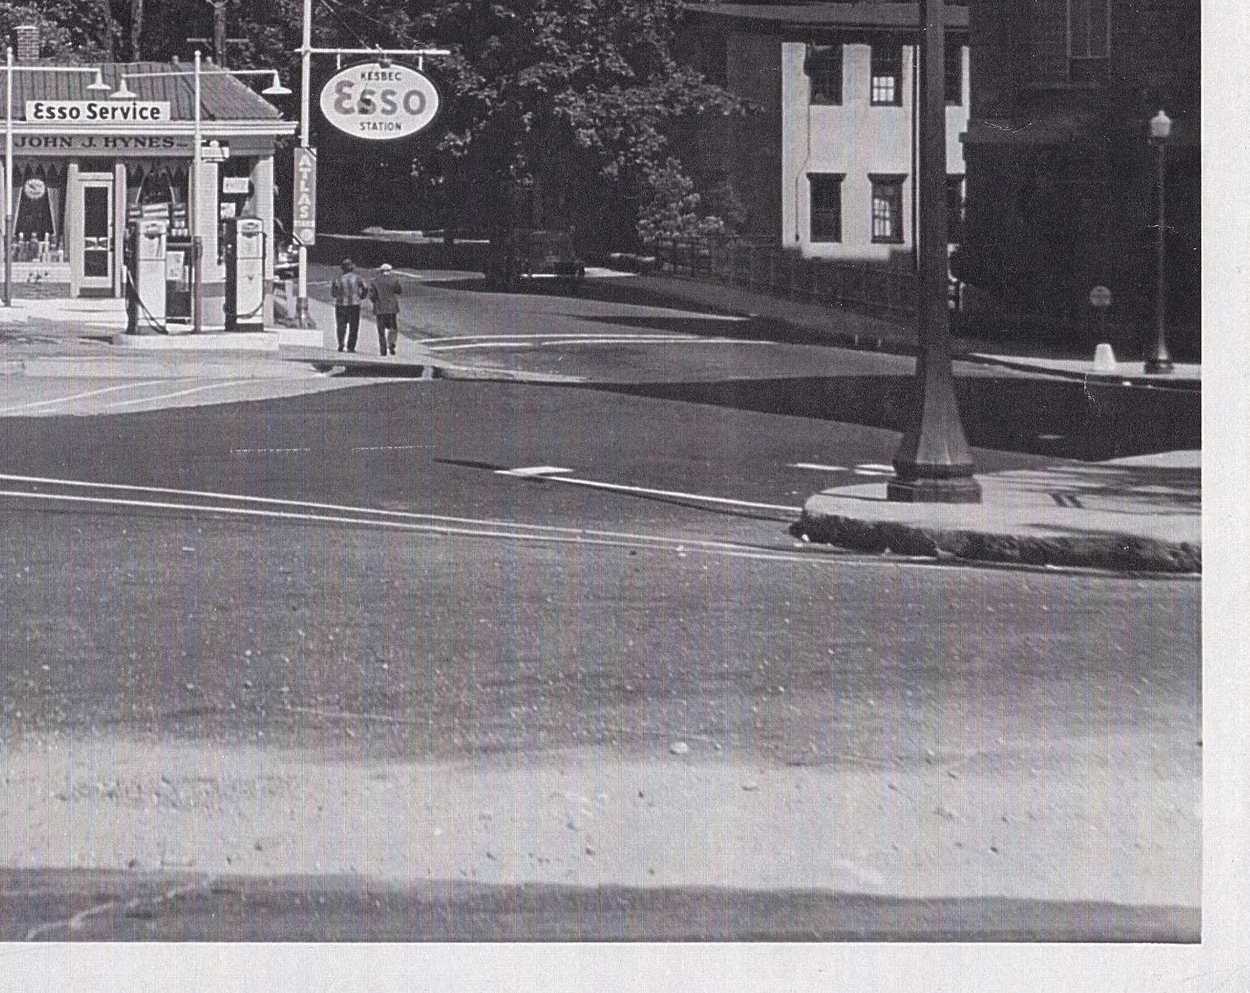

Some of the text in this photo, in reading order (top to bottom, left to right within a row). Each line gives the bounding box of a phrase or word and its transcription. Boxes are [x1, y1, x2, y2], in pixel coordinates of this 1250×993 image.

[360, 71, 402, 81] KESBEC
[33, 102, 161, 121] Esso Service
[359, 121, 402, 131] STATION
[13, 136, 73, 148] JOHN
[80, 136, 97, 148] J.
[103, 136, 175, 148] HYNES
[297, 153, 312, 219] ATLAS
